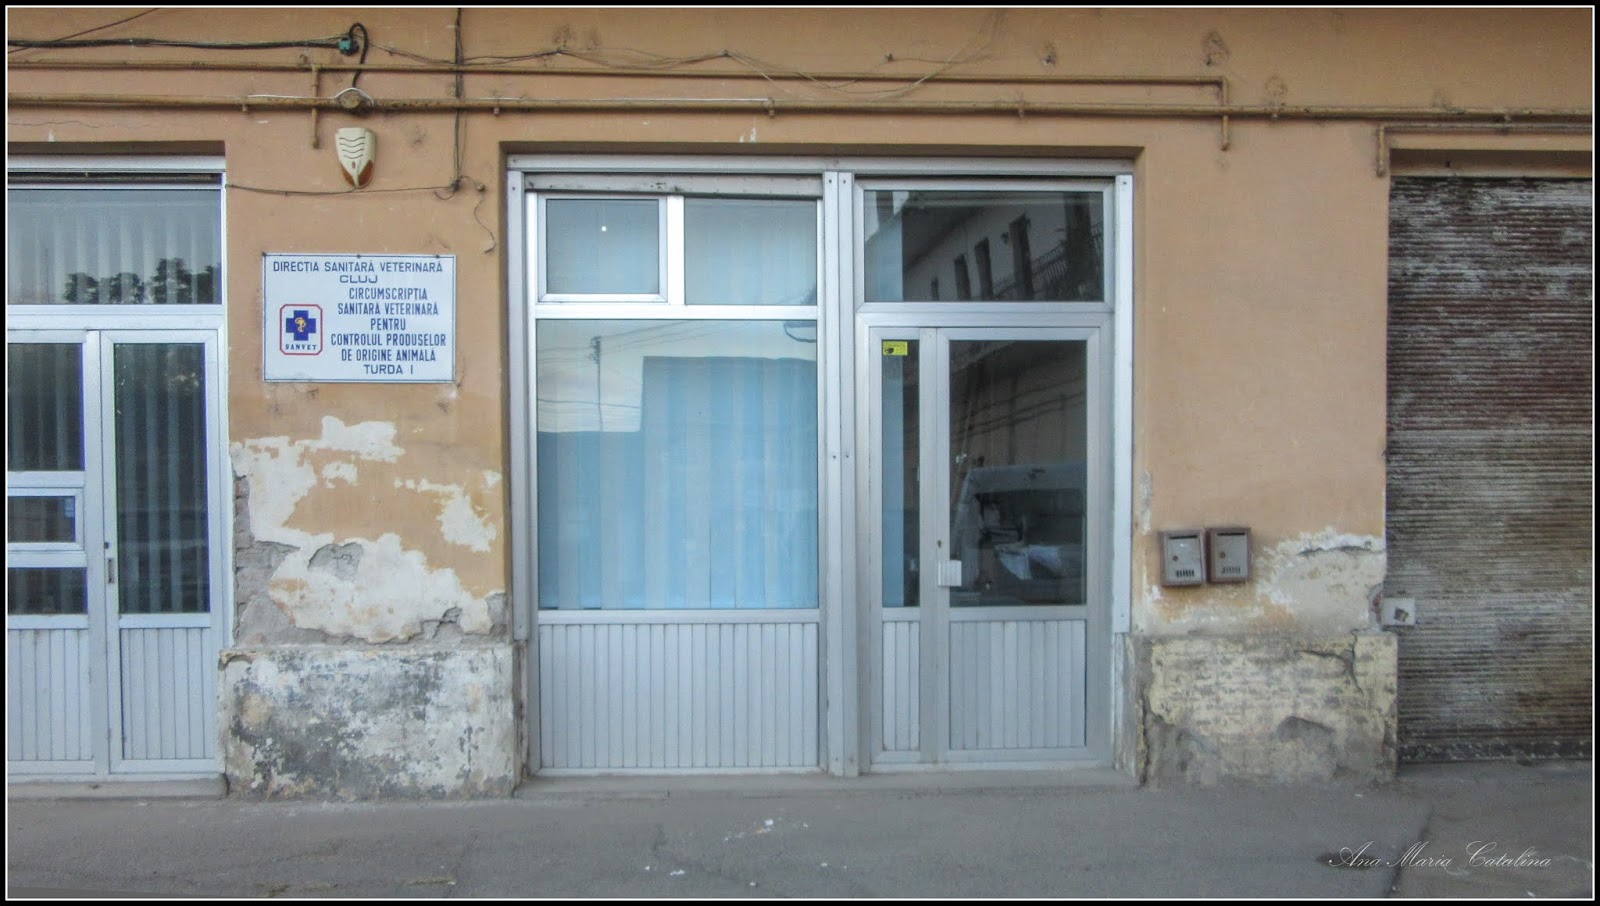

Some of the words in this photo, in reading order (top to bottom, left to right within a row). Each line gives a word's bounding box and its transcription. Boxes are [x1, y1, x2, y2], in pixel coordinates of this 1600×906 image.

[339, 275, 378, 284] CLUJ
[370, 318, 406, 331] PENTRU
[330, 333, 382, 346] CONTROLUL
[386, 333, 446, 347] PRODUSELOR
[341, 350, 352, 362] DE
[356, 350, 392, 362] ORIGINE
[363, 364, 404, 375] TURDA
